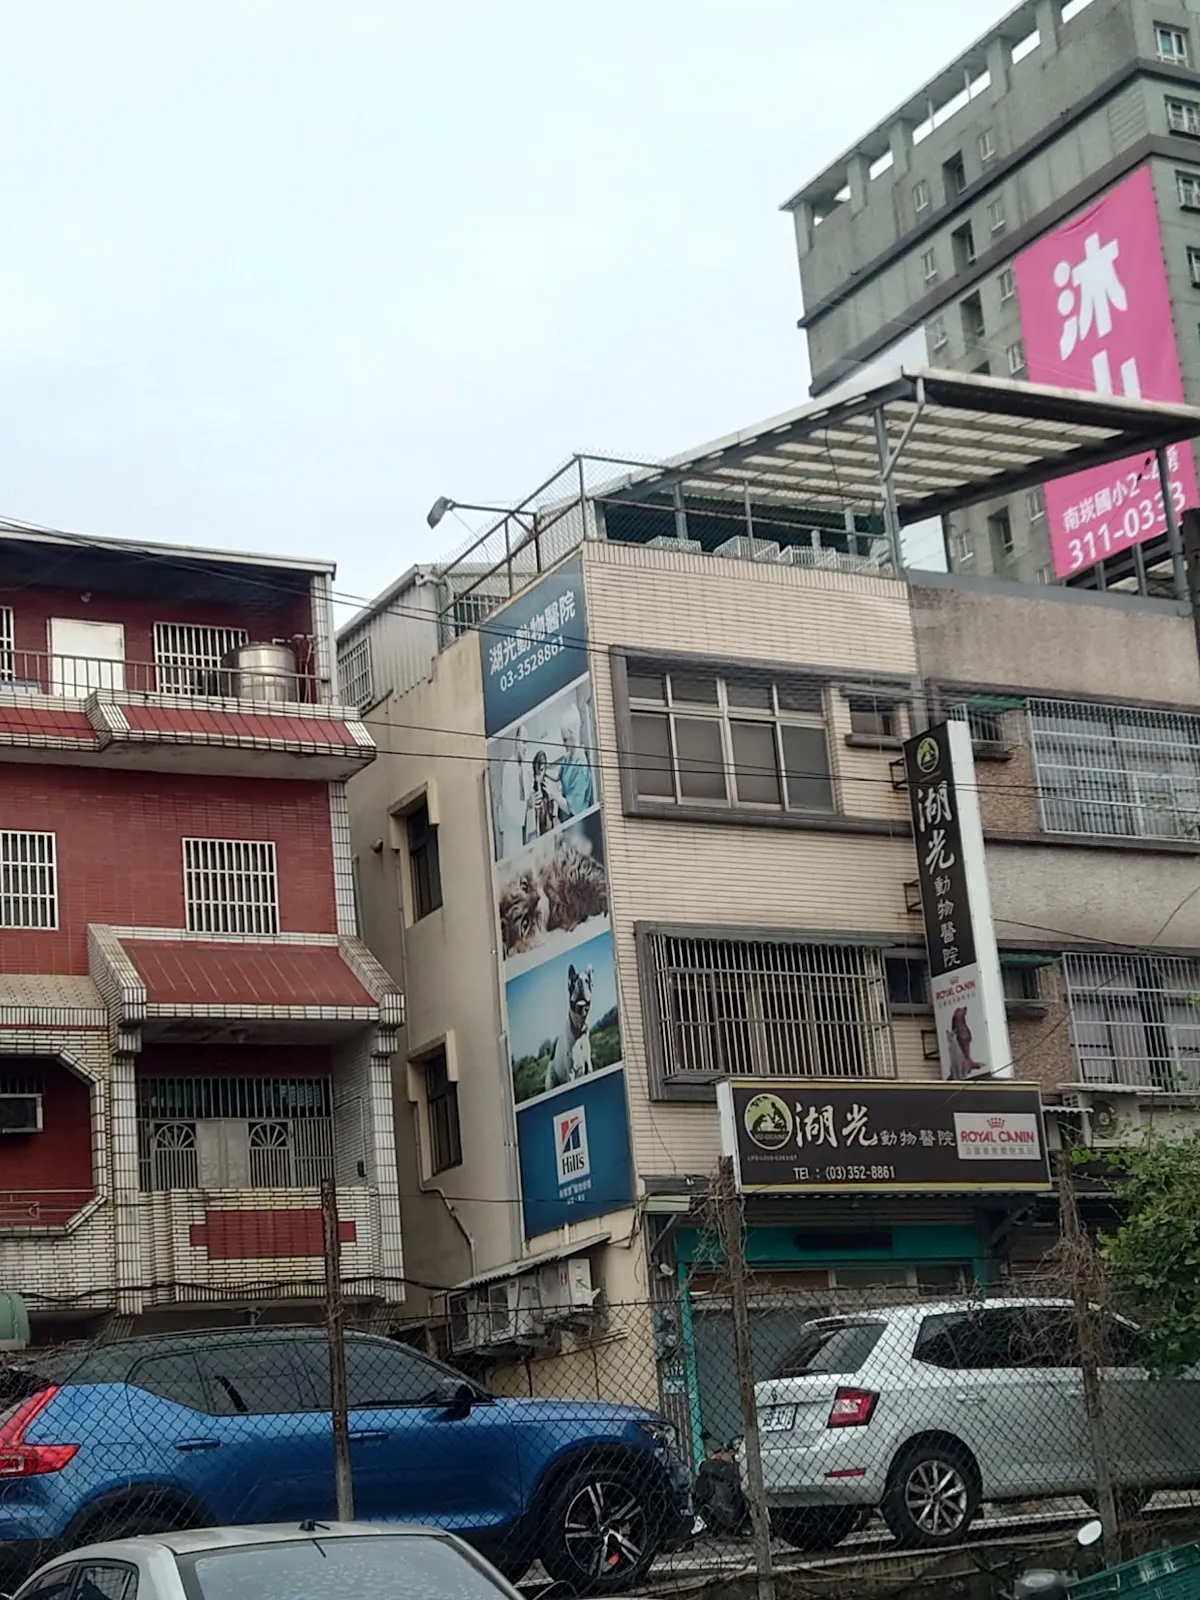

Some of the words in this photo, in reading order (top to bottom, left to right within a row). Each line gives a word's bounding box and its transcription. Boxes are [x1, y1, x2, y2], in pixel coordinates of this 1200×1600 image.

[489, 590, 576, 676] 湖光動物醫院
[500, 634, 565, 692] 03-3528861
[961, 1131, 996, 1142] ROYAL
[998, 1131, 1035, 1143] CANIN
